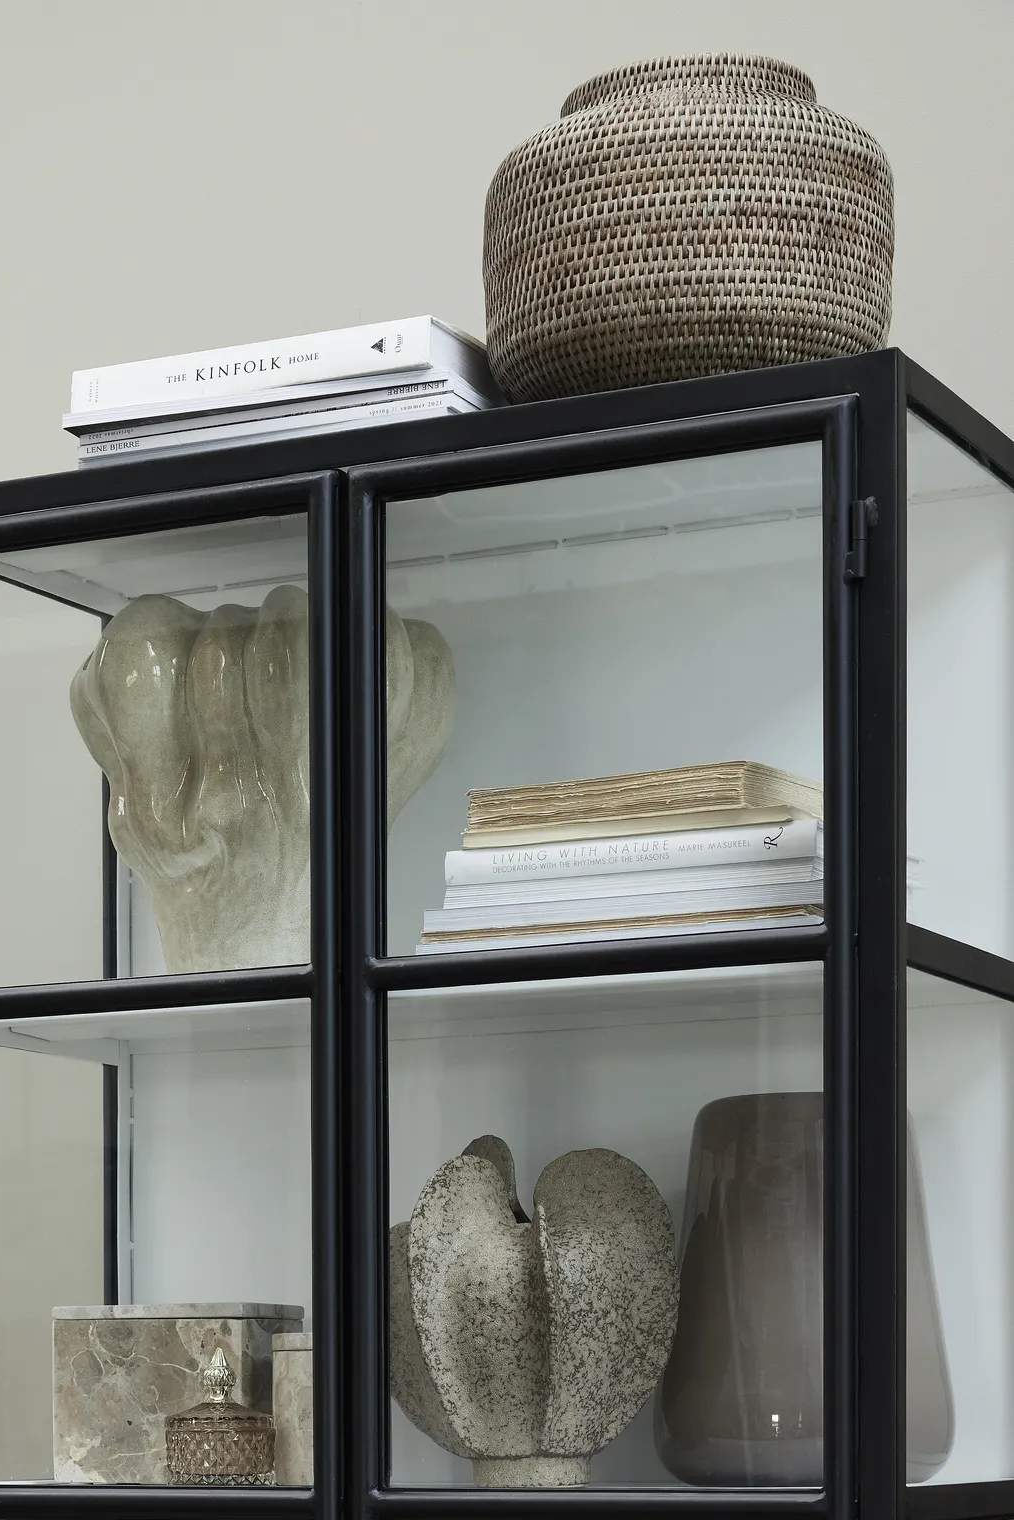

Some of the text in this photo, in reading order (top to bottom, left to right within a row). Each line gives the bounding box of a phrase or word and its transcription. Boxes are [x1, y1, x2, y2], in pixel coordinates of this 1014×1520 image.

[165, 352, 320, 384] THE KINFOLK HOME
[86, 440, 140, 454] LENE BJERRE
[492, 850, 547, 865] LIVING
[559, 846, 598, 859] WITH
[608, 839, 670, 855] NATURE
[678, 844, 705, 852] MARIE
[492, 864, 538, 874] DECORATING
[539, 861, 557, 869] WITH
[559, 860, 572, 868] THE
[573, 856, 606, 867] RHYTHMS
[621, 855, 633, 863] THE
[635, 853, 670, 862] SEASONS
